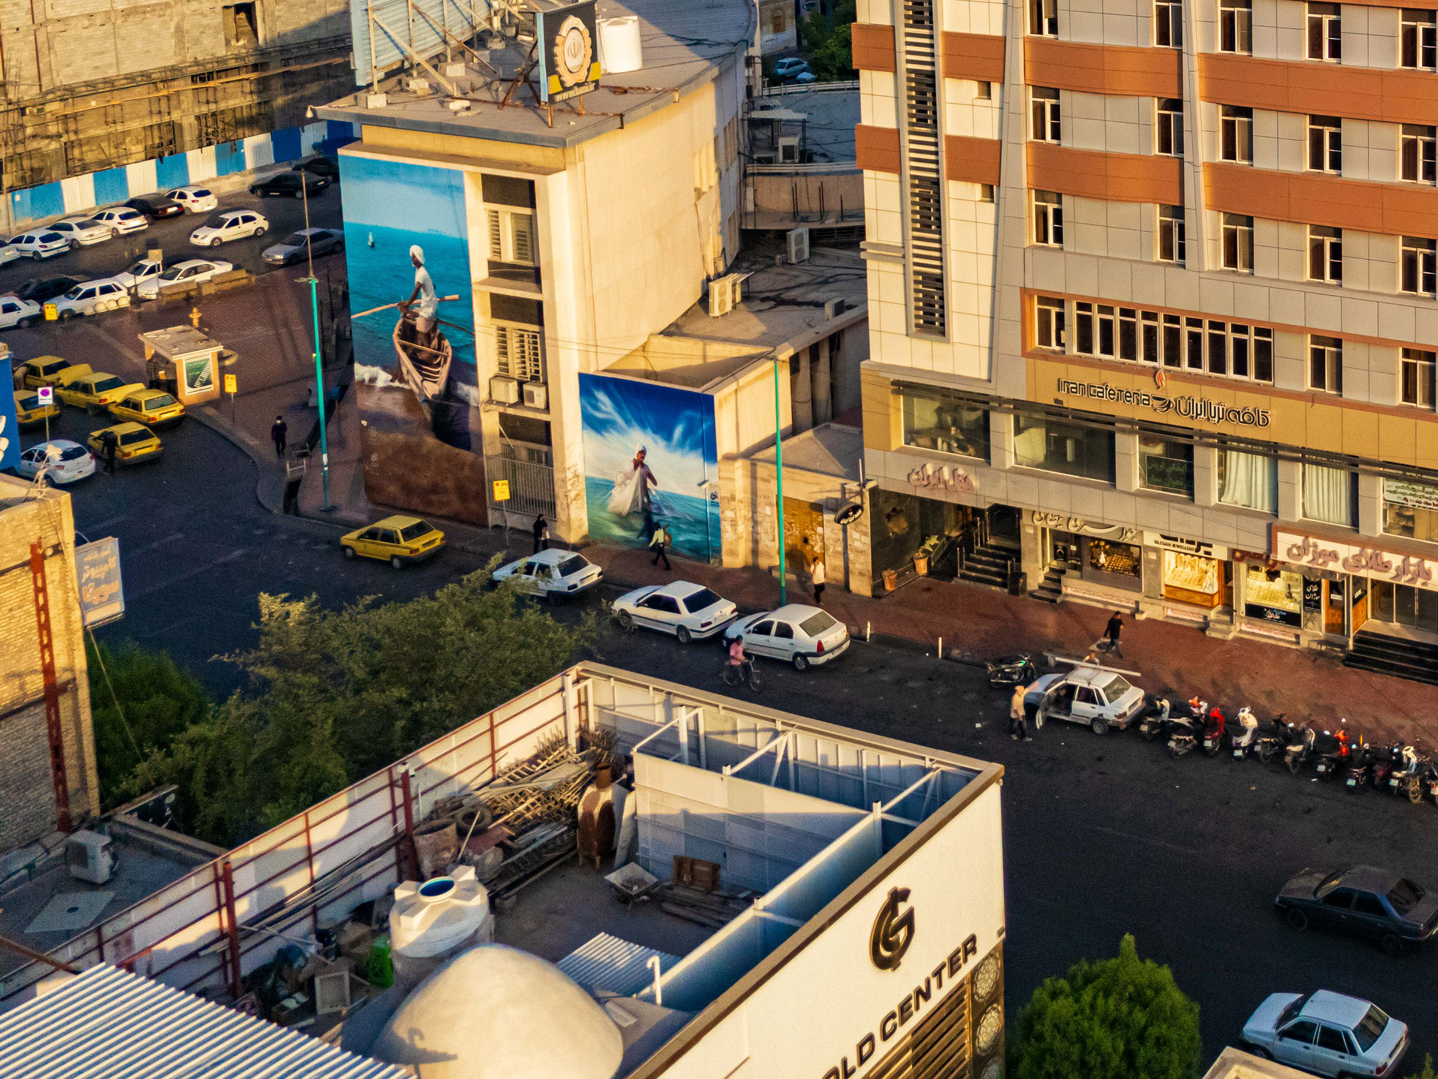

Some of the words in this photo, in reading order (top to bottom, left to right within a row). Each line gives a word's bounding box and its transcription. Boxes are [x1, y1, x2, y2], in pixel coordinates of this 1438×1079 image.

[1176, 397, 1207, 420] ایران
[1208, 401, 1226, 424] تریا
[1227, 407, 1271, 427] کافه
[1287, 536, 1340, 568] موژان
[1342, 547, 1393, 572] طلای
[1390, 555, 1433, 586] بازار
[880, 933, 978, 1042] CENTER
